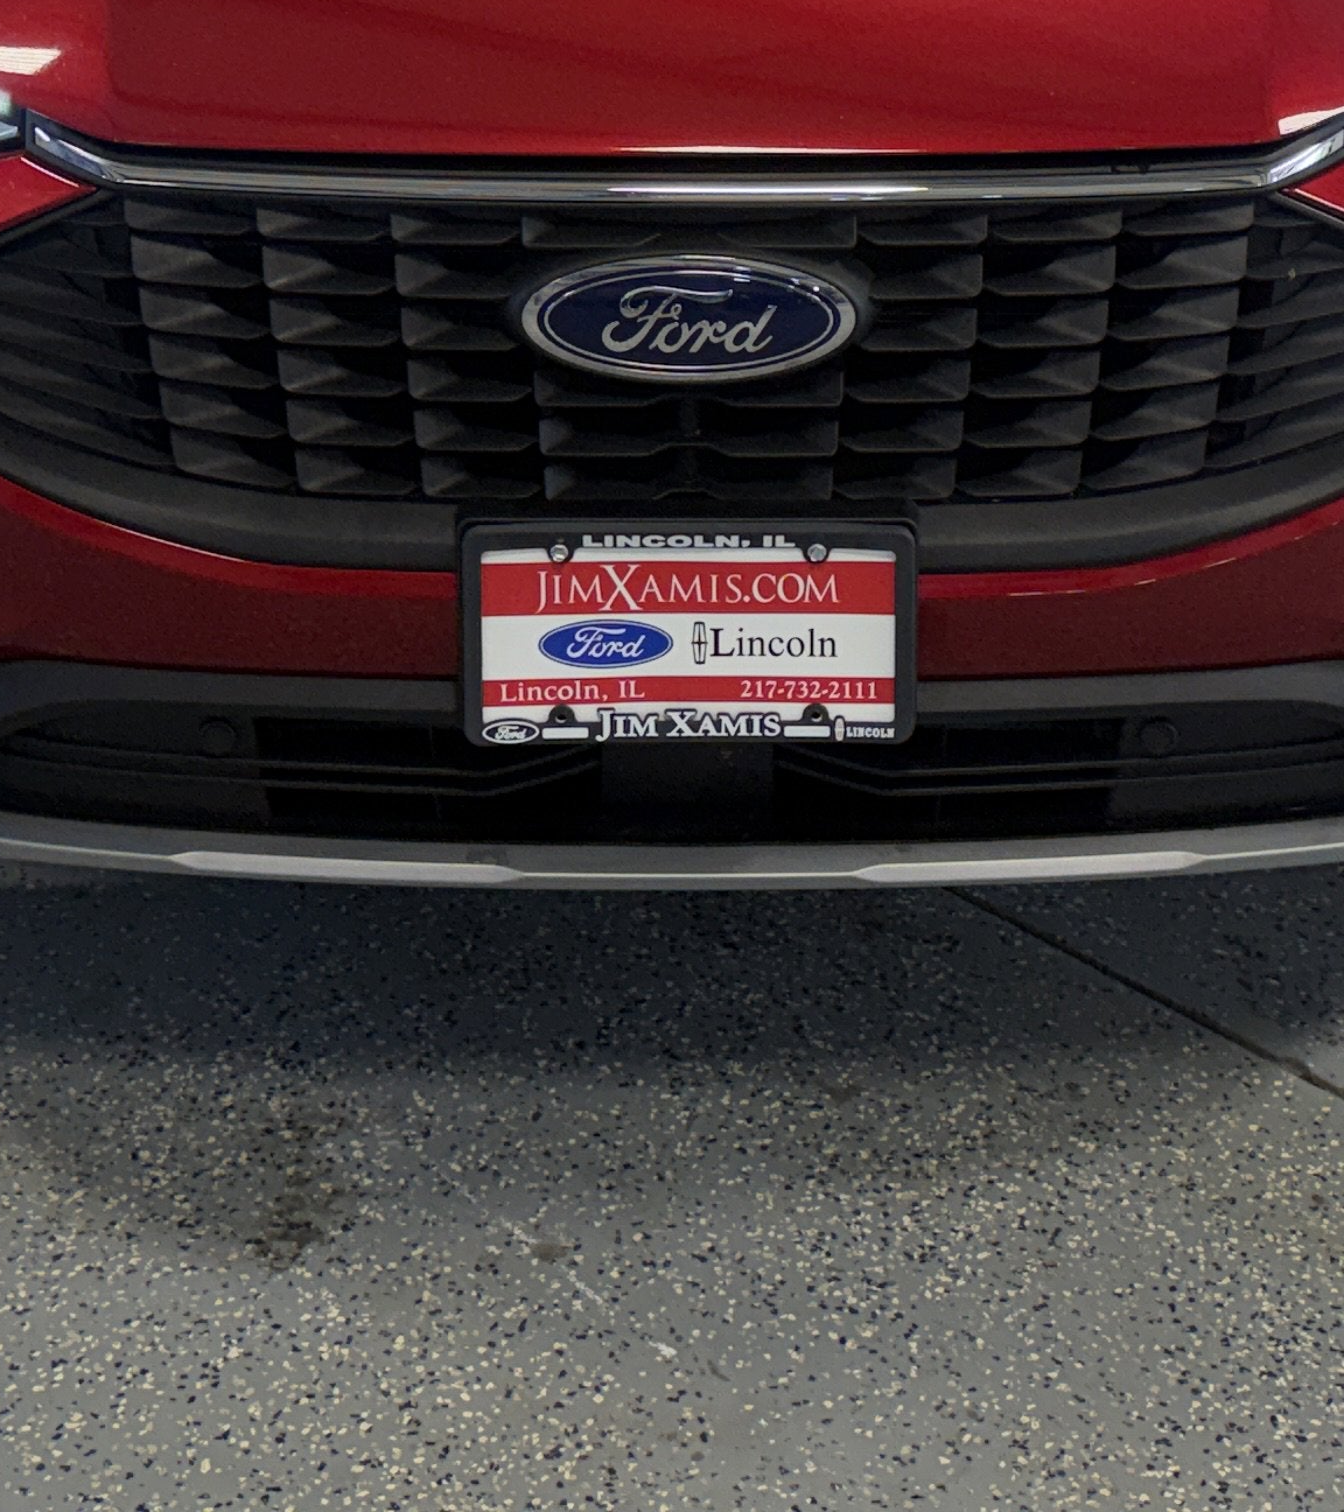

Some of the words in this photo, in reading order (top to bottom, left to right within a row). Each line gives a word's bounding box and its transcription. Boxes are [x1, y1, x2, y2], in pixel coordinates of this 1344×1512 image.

[601, 284, 778, 354] Ford
[581, 534, 750, 549] LINCOLN,
[761, 534, 796, 548] IL
[533, 563, 840, 615] JIMXAMIS.COM
[566, 626, 644, 659] Ford
[709, 627, 838, 658] Lincoln
[499, 680, 608, 703] Lincoln,
[619, 680, 646, 700] IL
[739, 679, 878, 701] 217-732-2111
[595, 709, 658, 742] JIM
[665, 710, 782, 738] XAMIS
[845, 726, 895, 739] LINCOLN
